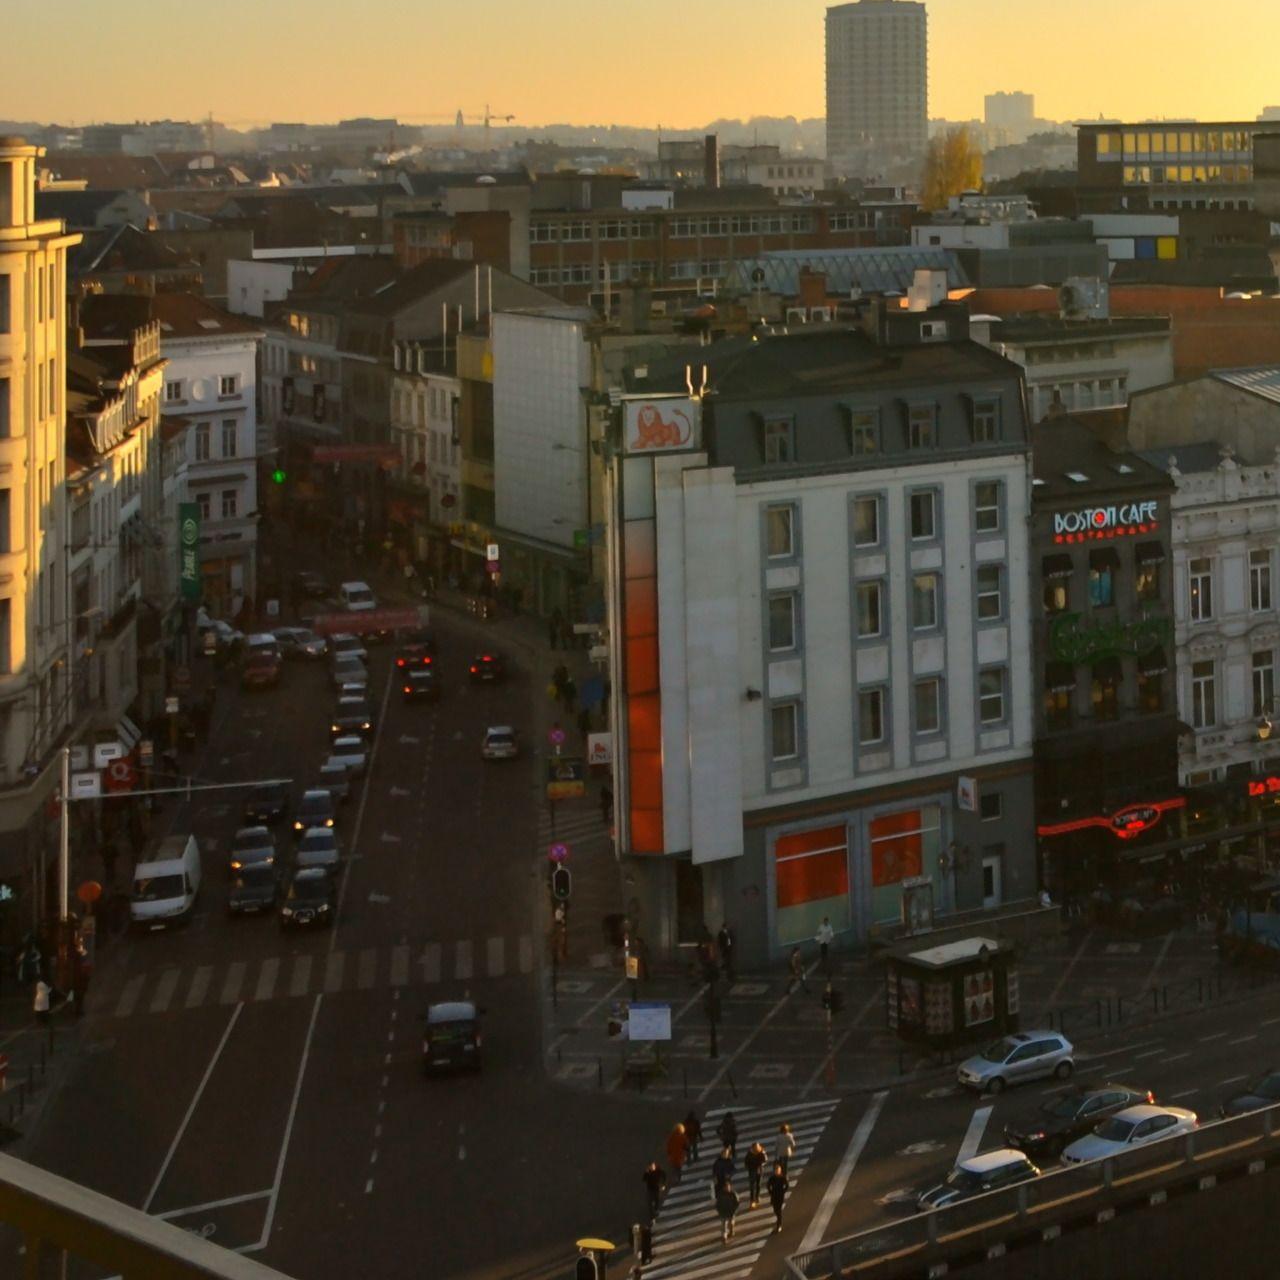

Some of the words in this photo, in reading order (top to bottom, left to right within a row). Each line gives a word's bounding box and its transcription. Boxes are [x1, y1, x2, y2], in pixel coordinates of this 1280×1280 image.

[1054, 506, 1116, 534] BOSTON
[1119, 501, 1157, 524] CAFE
[1053, 521, 1159, 545] RESTAURANT
